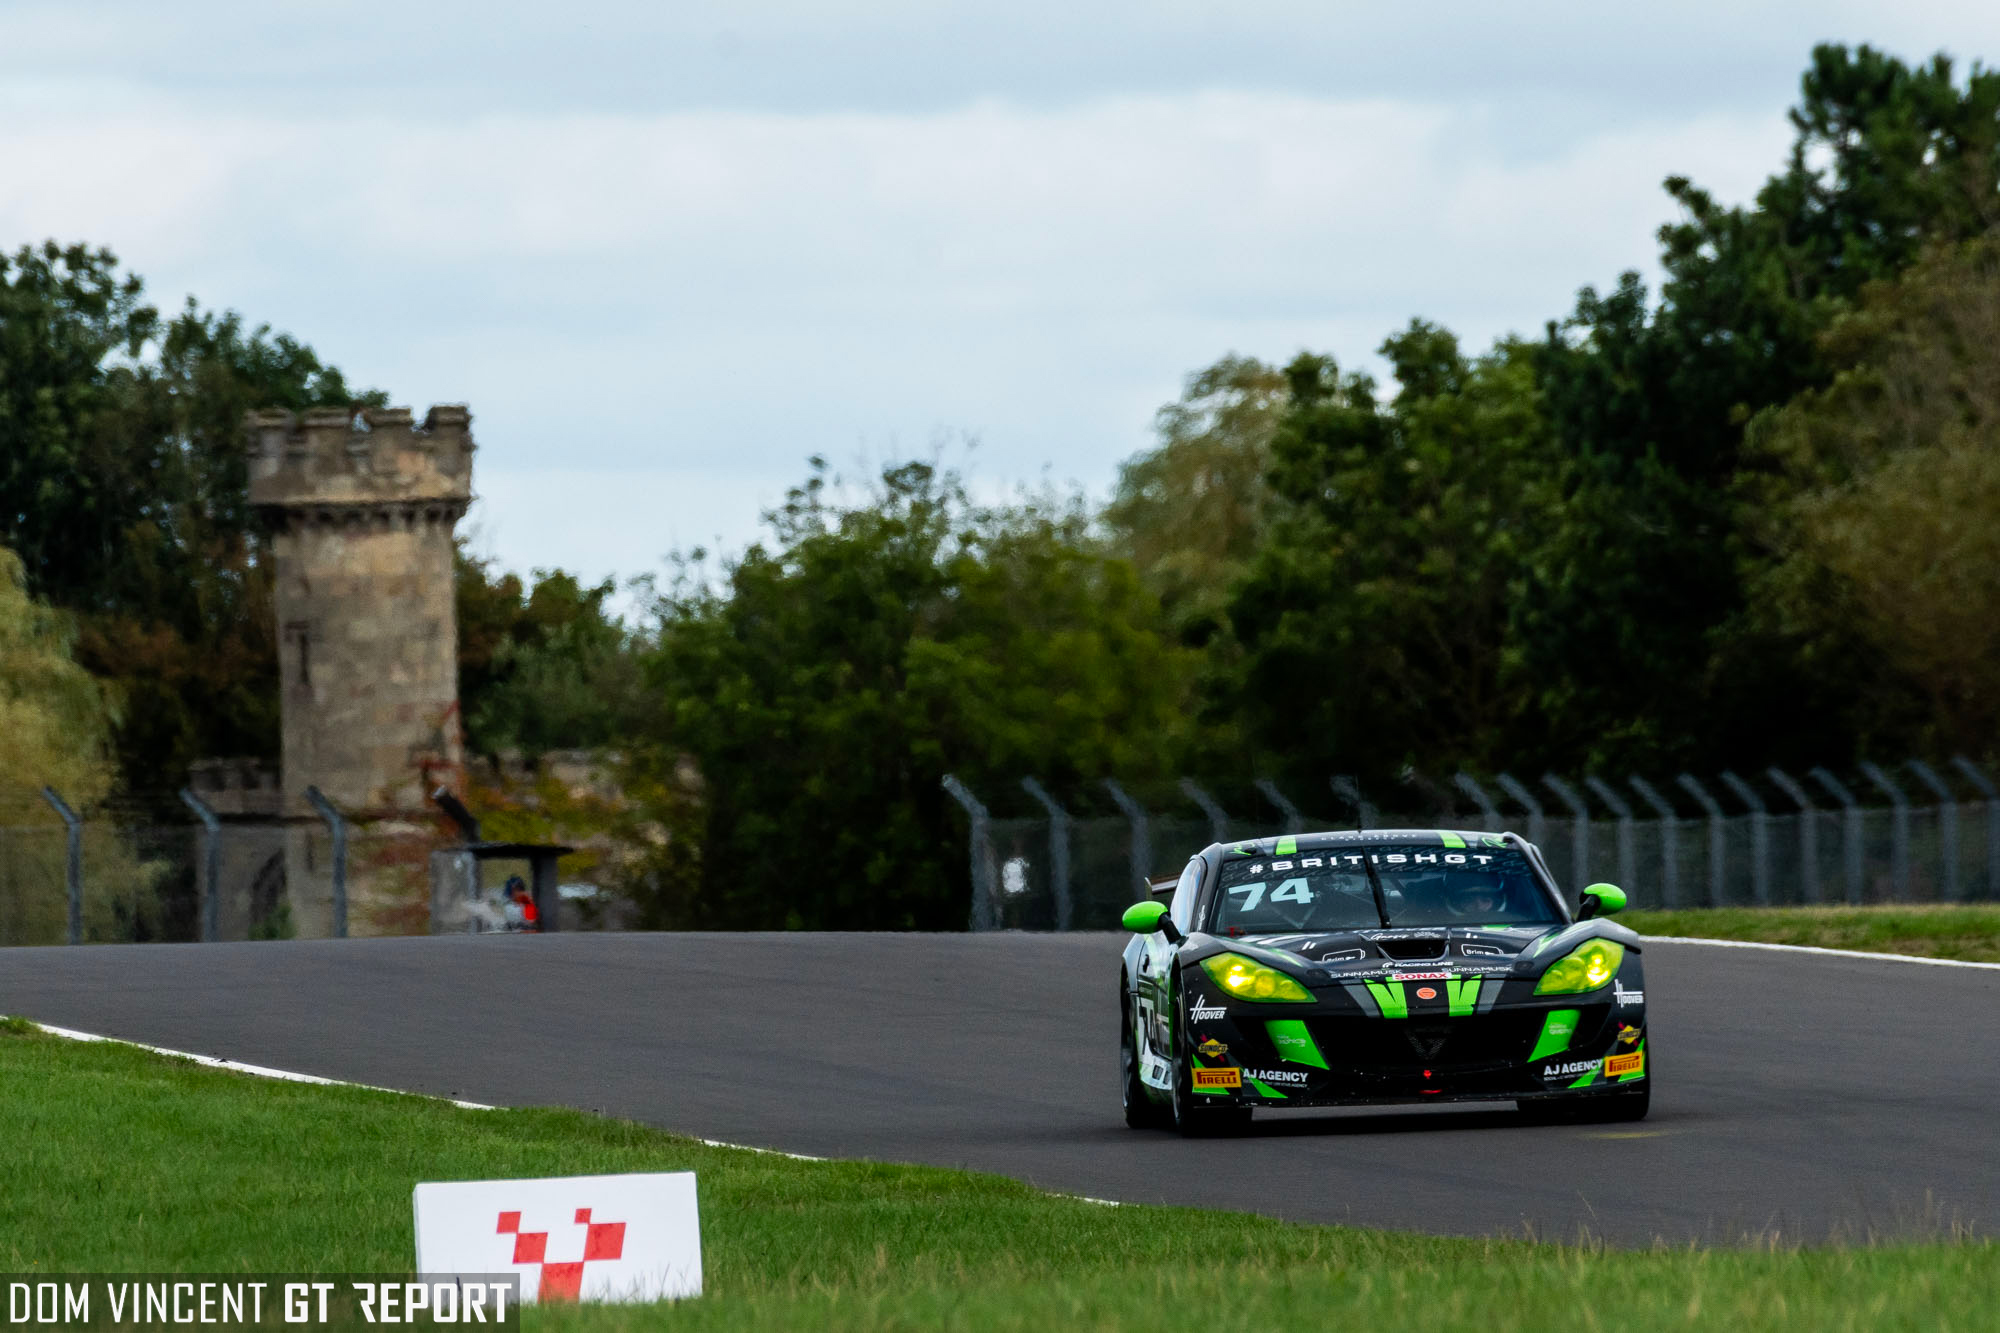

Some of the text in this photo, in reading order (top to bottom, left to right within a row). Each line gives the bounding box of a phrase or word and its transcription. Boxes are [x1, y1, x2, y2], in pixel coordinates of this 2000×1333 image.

[1250, 854, 1492, 874] #BRITISHGT
[1228, 878, 1314, 912] 74
[1331, 969, 1402, 978] SUNNAMUSK
[1544, 1058, 1604, 1076] AJ AGENCY
[1609, 1055, 1641, 1073] PIRELLI
[1196, 1071, 1237, 1085] PIRELLI
[1243, 1068, 1257, 1079] AJ
[1259, 1070, 1308, 1082] AGENCY
